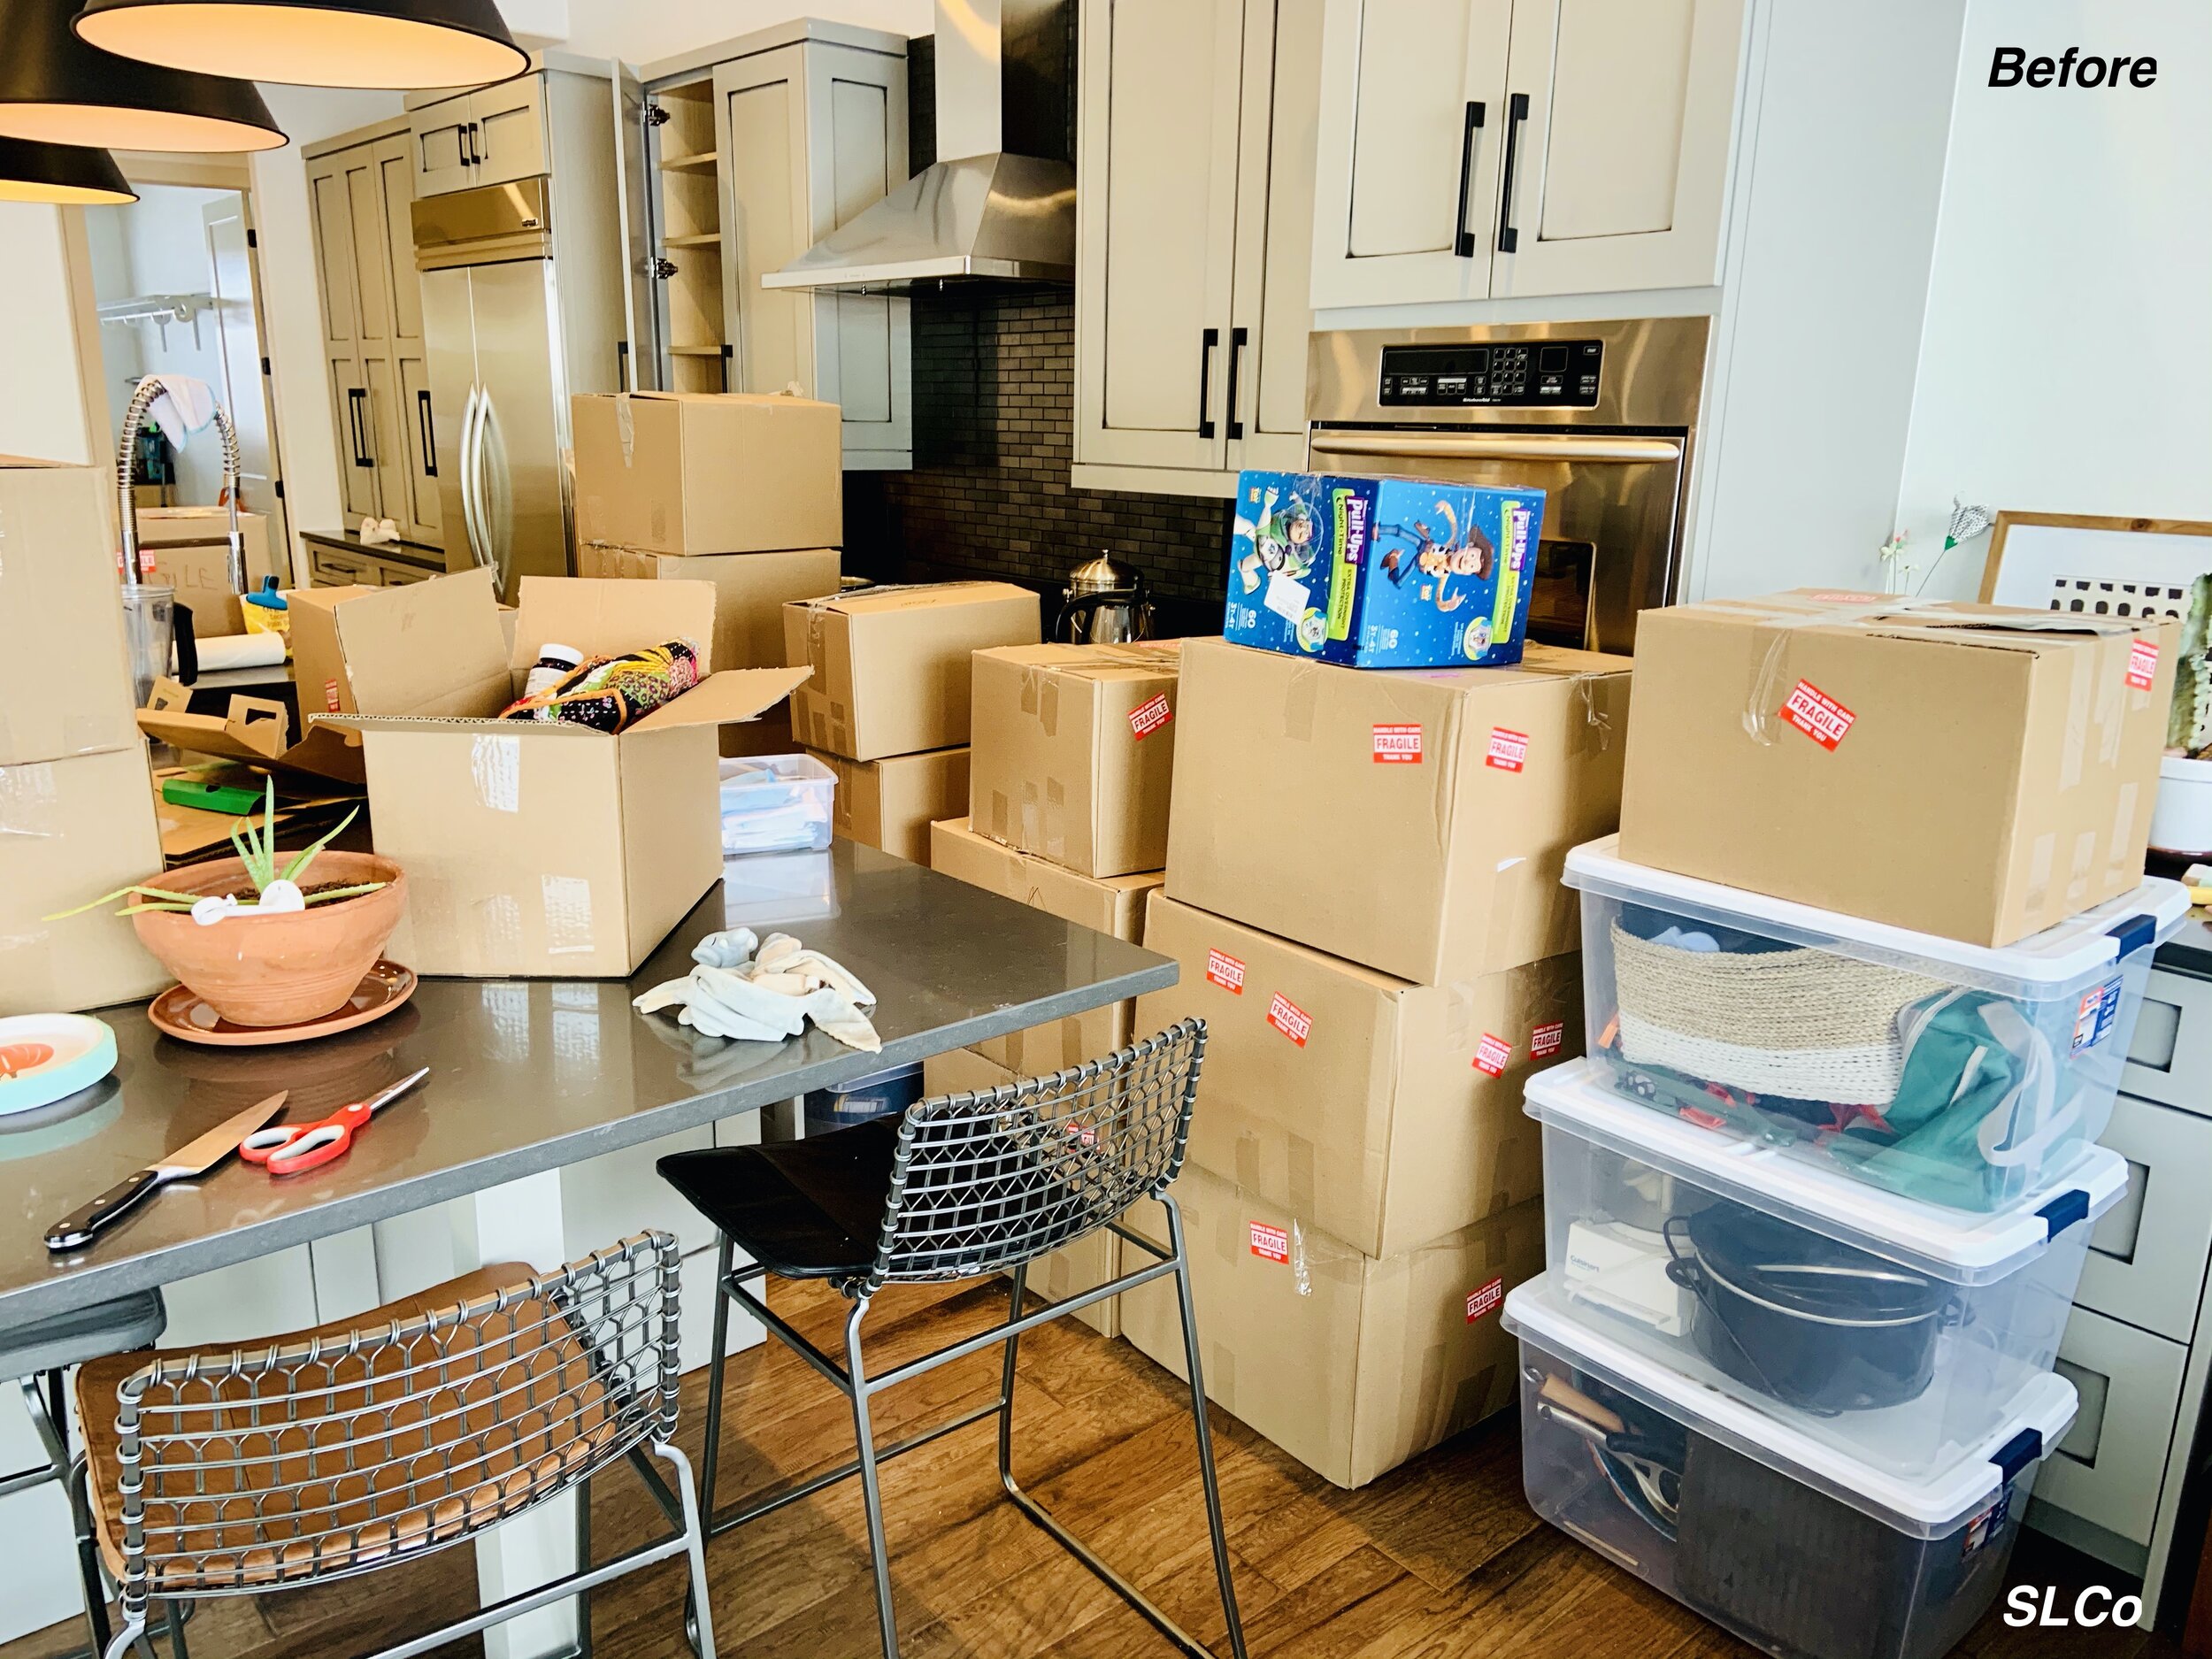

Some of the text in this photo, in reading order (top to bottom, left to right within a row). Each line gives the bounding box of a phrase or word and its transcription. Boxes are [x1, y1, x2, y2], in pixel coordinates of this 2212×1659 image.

[1248, 610, 1256, 628] 60
[1389, 629, 1398, 649] 60
[1798, 681, 1855, 724] HANDLE WITH CARE
[1134, 703, 1167, 730] FRAGILE
[1792, 695, 1844, 736] FRAGILE
[1793, 714, 1827, 741] THANK YOU
[1377, 738, 1419, 749] FRAGILE
[1491, 741, 1524, 759] FRAGILE
[1210, 960, 1241, 982] FRAGILE
[1272, 1003, 1307, 1036] FRAGILE
[1532, 1032, 1561, 1048] FRAGILE
[1479, 1046, 1506, 1066] FRAGILE
[1253, 1233, 1286, 1252] FRAGILE
[1469, 1286, 1501, 1313] FRAGILE
